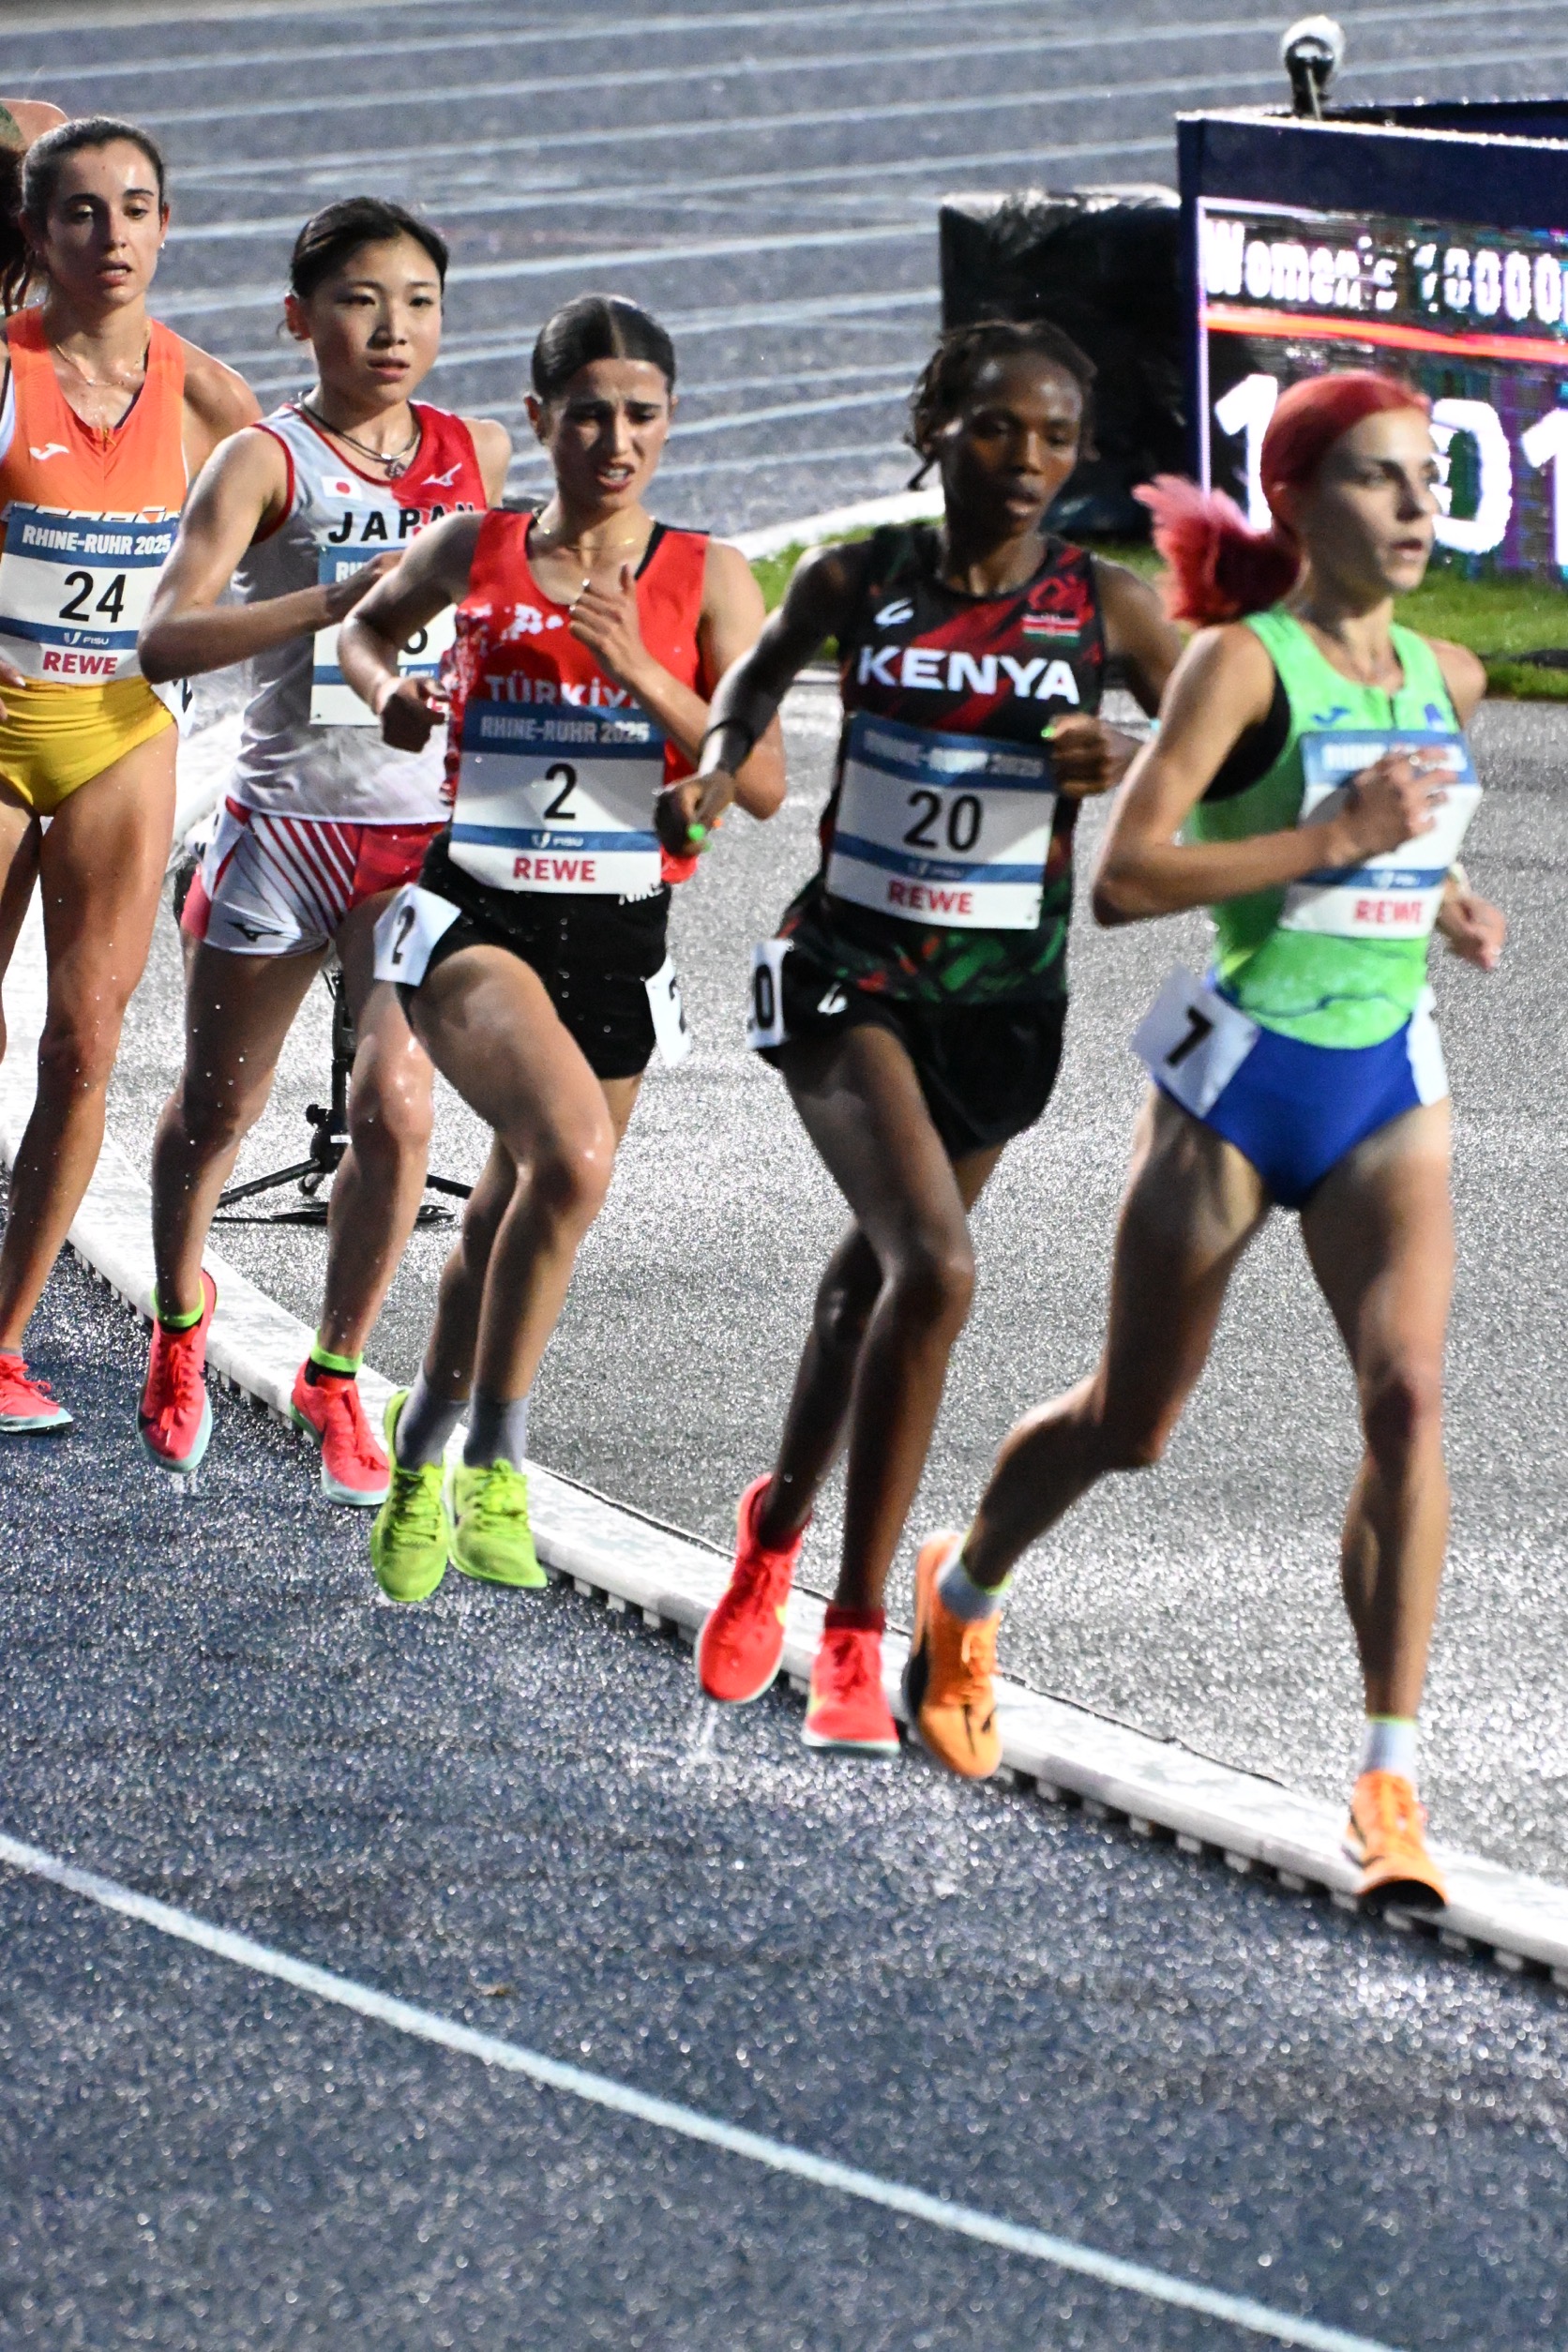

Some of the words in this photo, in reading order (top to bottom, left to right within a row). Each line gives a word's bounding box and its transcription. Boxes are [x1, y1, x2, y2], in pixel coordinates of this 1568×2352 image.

[1205, 220, 1397, 311] Women's
[1413, 243, 1568, 324] 10000
[22, 524, 133, 555] RHINE-RUHR
[134, 534, 172, 555] 2025
[328, 503, 475, 544] JAP
[59, 570, 127, 623] 24
[42, 651, 118, 675] REWE
[857, 644, 1079, 704] KENYA
[485, 670, 641, 710] TÜRKİY
[480, 716, 597, 743] RHINE-RUHR
[600, 720, 651, 744] 2025
[544, 762, 578, 820] 2
[903, 790, 983, 852] 20
[512, 857, 596, 882] REWE
[888, 880, 973, 915] REWE
[392, 905, 415, 965] 2
[747, 964, 775, 1030] 0
[1166, 1005, 1214, 1066] 7
